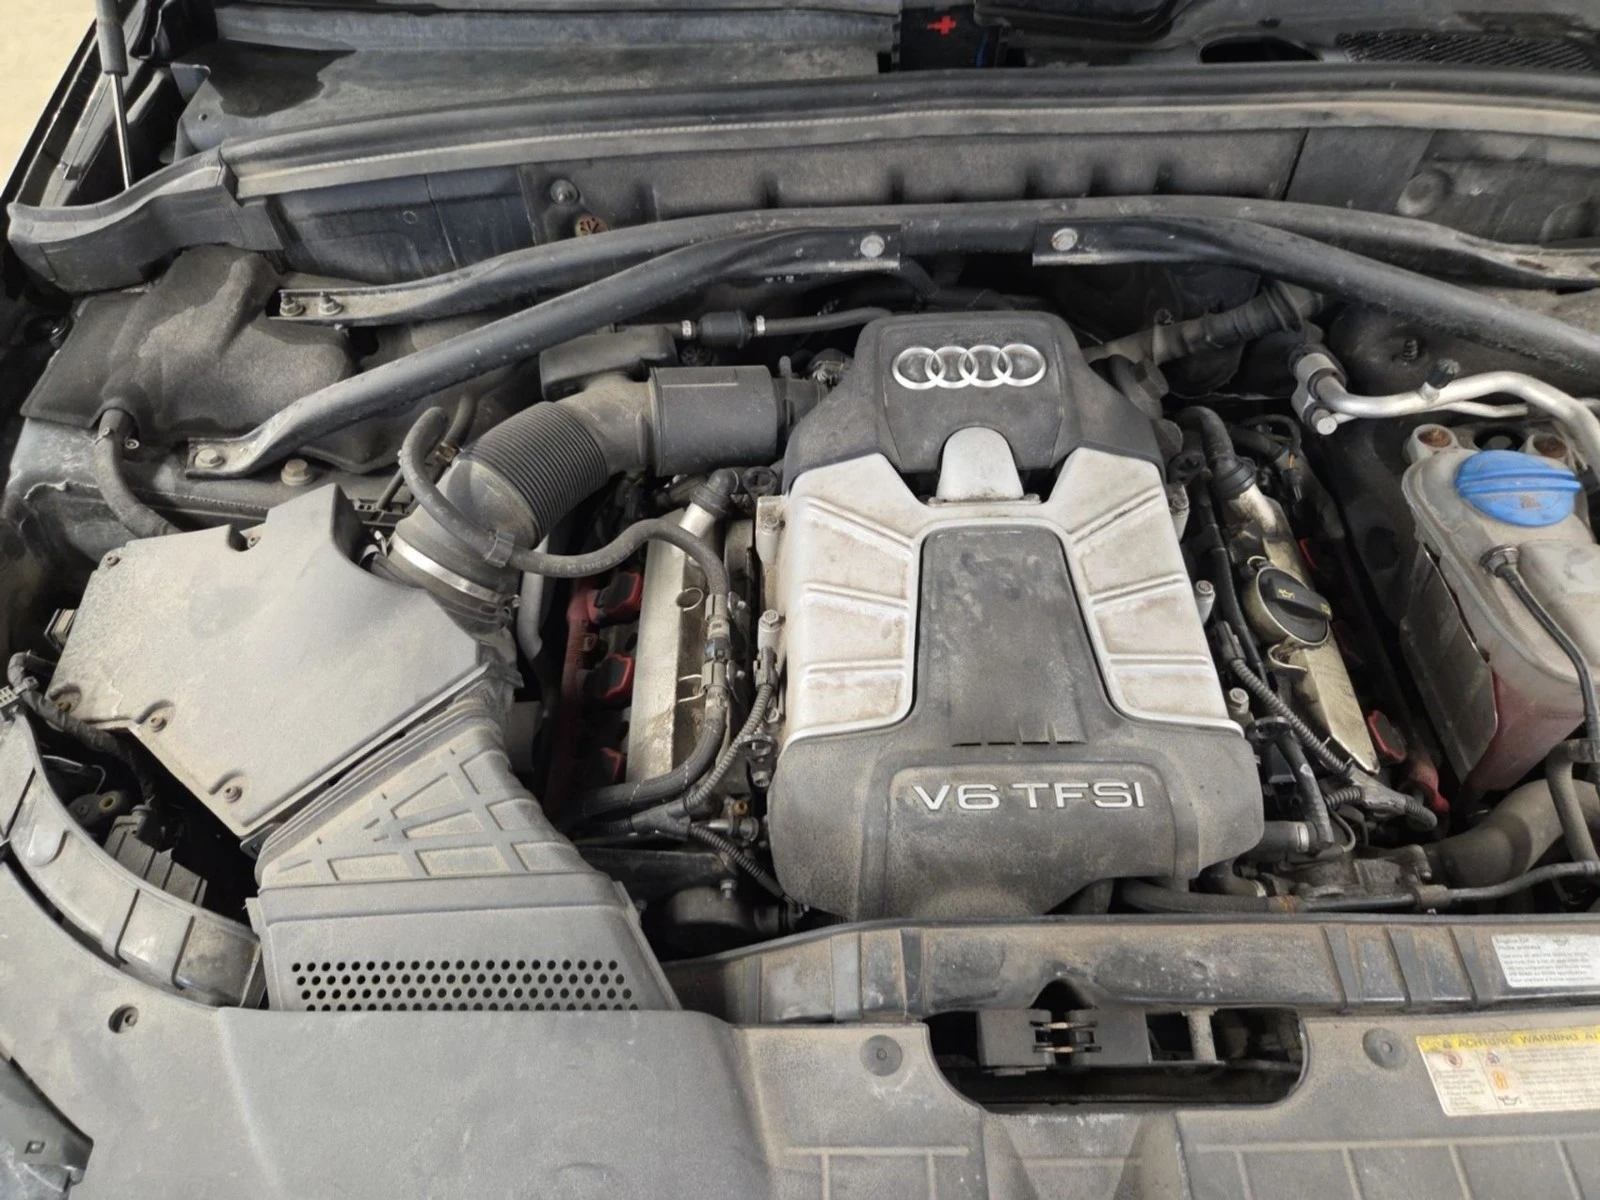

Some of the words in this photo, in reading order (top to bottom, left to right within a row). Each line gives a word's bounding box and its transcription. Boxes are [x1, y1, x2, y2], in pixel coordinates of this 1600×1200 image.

[913, 783, 1000, 811] V6
[1012, 781, 1145, 809] TFSI
[1520, 1032, 1579, 1044] WARNING
